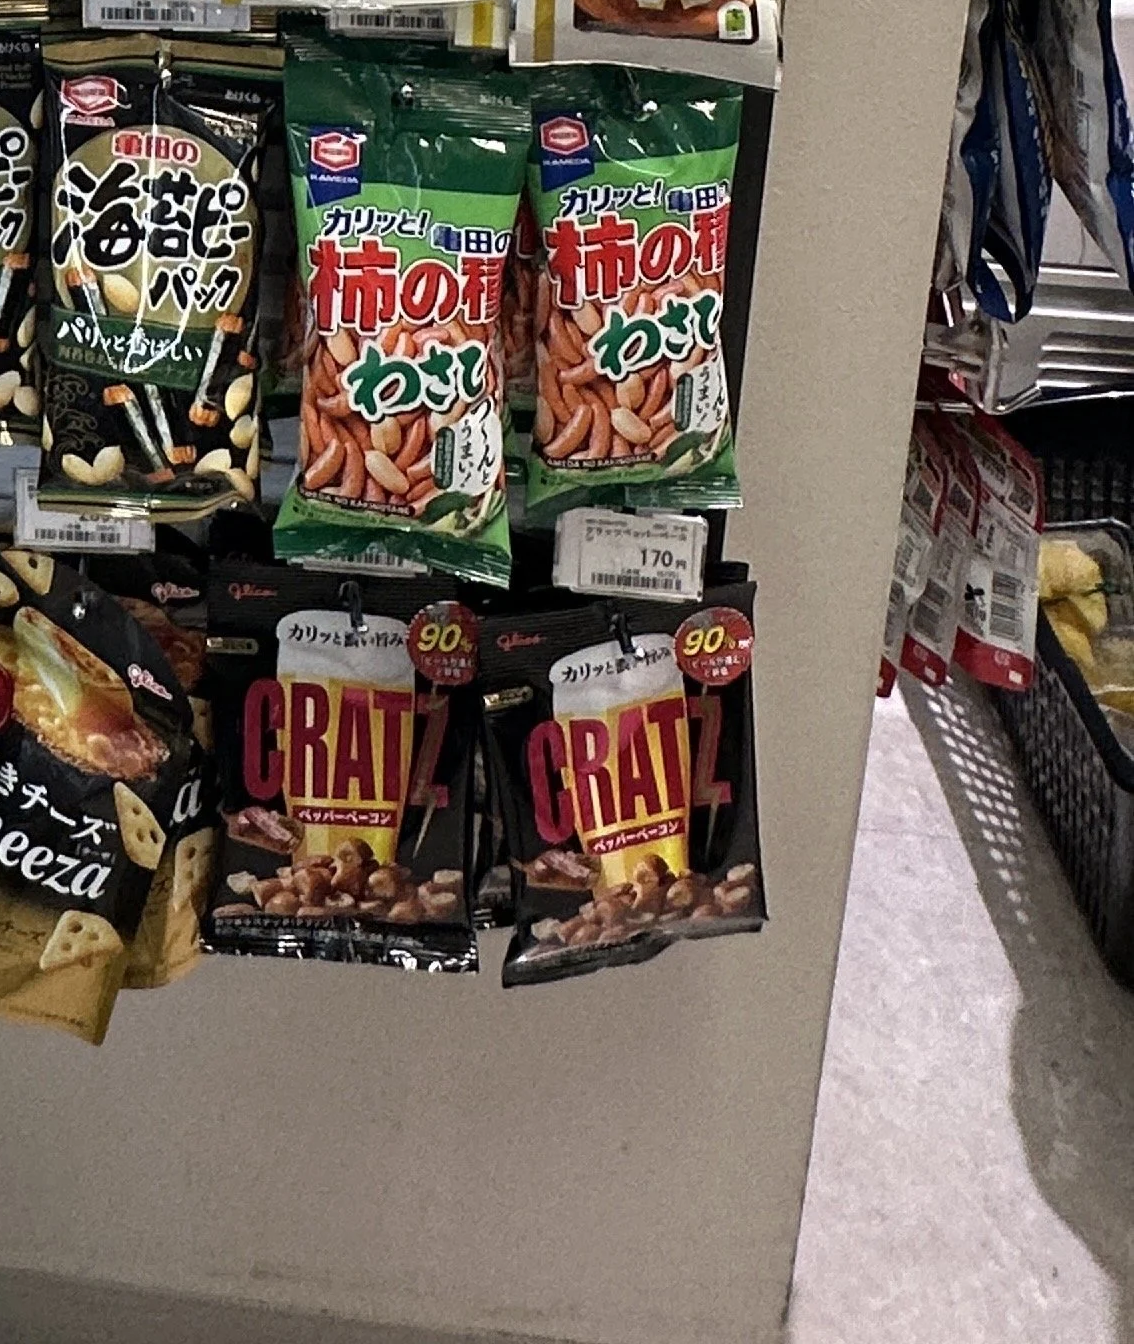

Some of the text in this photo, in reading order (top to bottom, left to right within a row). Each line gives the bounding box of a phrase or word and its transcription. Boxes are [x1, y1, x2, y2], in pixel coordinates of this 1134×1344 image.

[112, 131, 201, 163] 亀田の
[54, 161, 252, 269] 海苔ピー
[562, 181, 664, 216] カリッと！
[324, 207, 430, 240] カリッと！
[433, 224, 512, 255] 亀田の
[147, 265, 242, 313] パック
[242, 678, 450, 809] CRATZ
[526, 693, 733, 847] CRATZ
[298, 809, 392, 826] ペッパーベーコン
[592, 819, 683, 854] ペッパーベーコン
